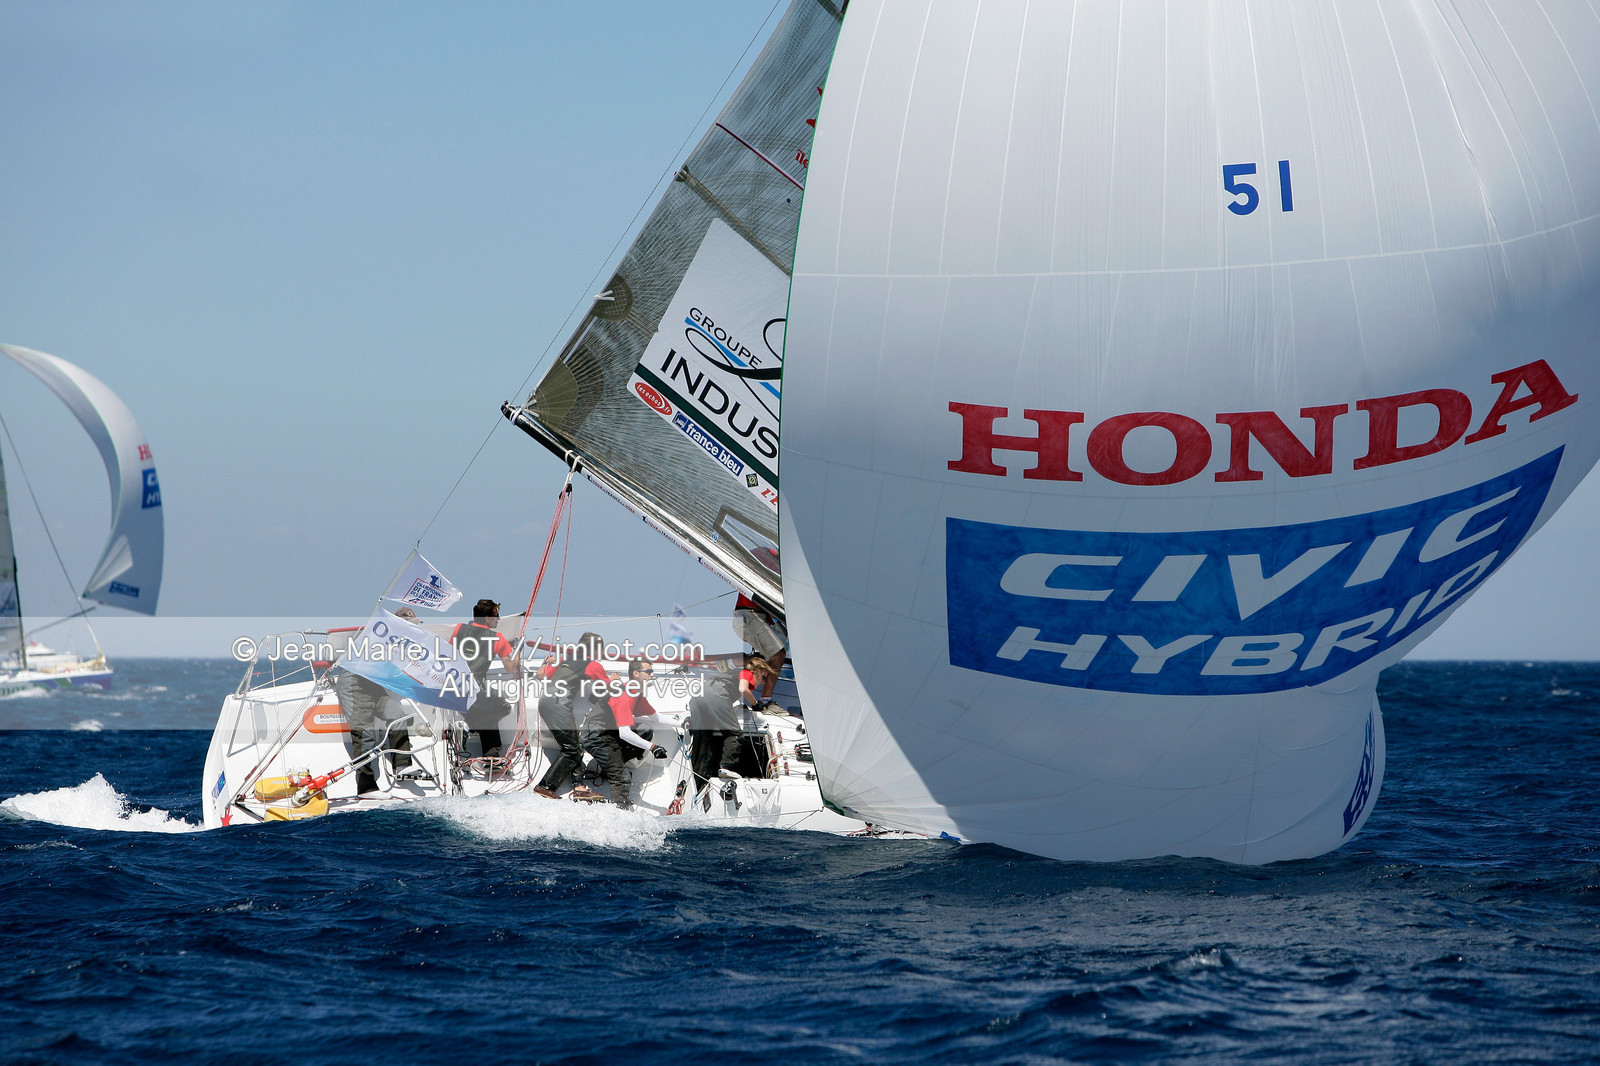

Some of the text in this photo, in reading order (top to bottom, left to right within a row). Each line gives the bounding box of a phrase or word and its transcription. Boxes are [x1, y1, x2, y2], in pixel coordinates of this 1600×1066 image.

[1222, 159, 1294, 216] 51
[688, 306, 763, 370] GROUPE
[659, 348, 779, 460] INDUS
[685, 422, 741, 475] france bleu
[947, 358, 1580, 487] HONDA
[999, 486, 1522, 621] CIVIC
[995, 550, 1499, 676] HYBRID
